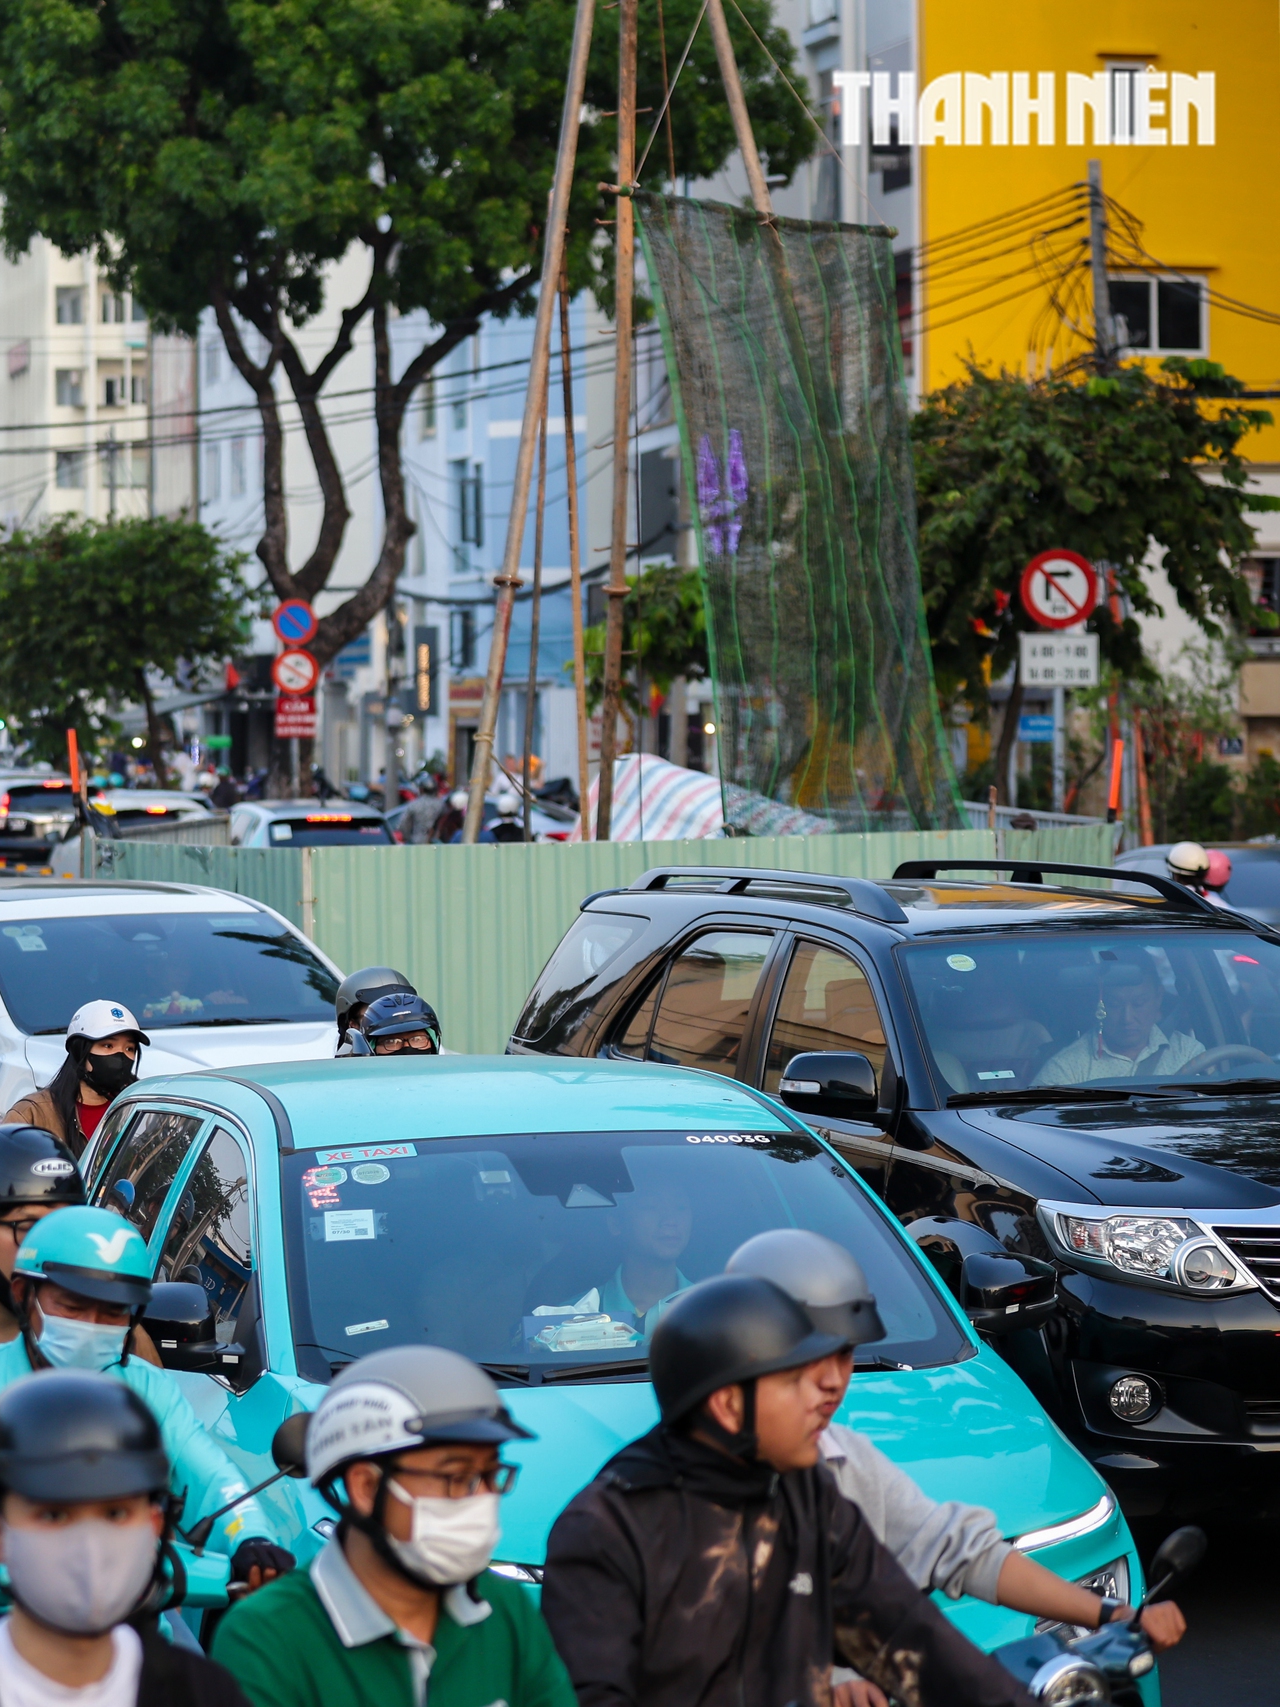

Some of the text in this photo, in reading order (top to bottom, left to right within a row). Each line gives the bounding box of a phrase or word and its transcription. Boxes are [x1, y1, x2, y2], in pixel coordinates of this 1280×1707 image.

[686, 1135, 771, 1144] 04003G
[325, 1146, 410, 1162] XE TAXI
[41, 1163, 72, 1173] HJC
